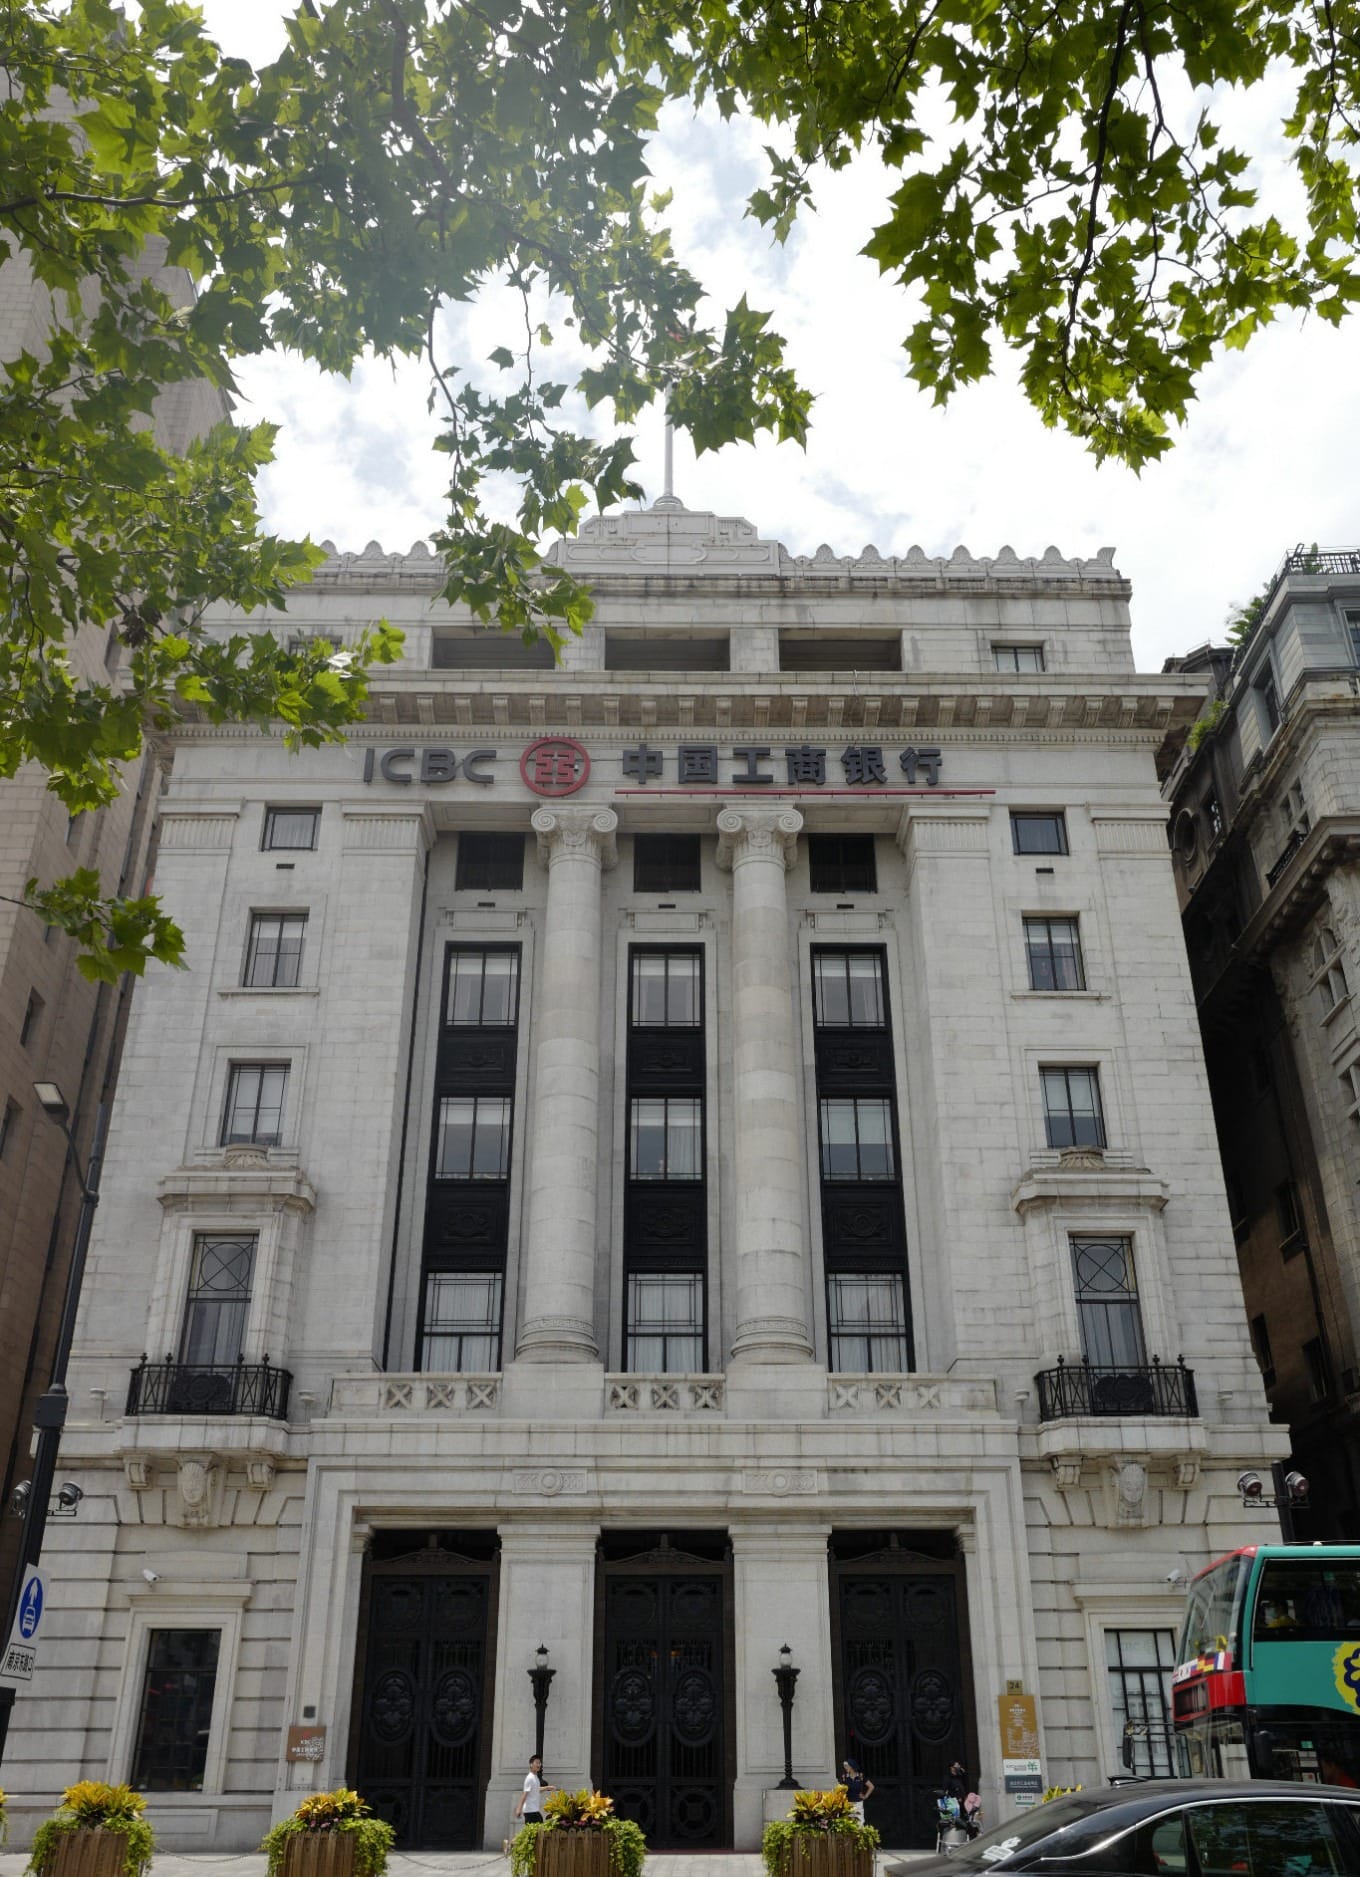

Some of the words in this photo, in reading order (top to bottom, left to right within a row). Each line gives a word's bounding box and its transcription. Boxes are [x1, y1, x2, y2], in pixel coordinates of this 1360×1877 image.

[363, 748, 497, 784] ICBC
[622, 743, 943, 786] 中国工商银行
[1009, 1681, 1020, 1689] 24
